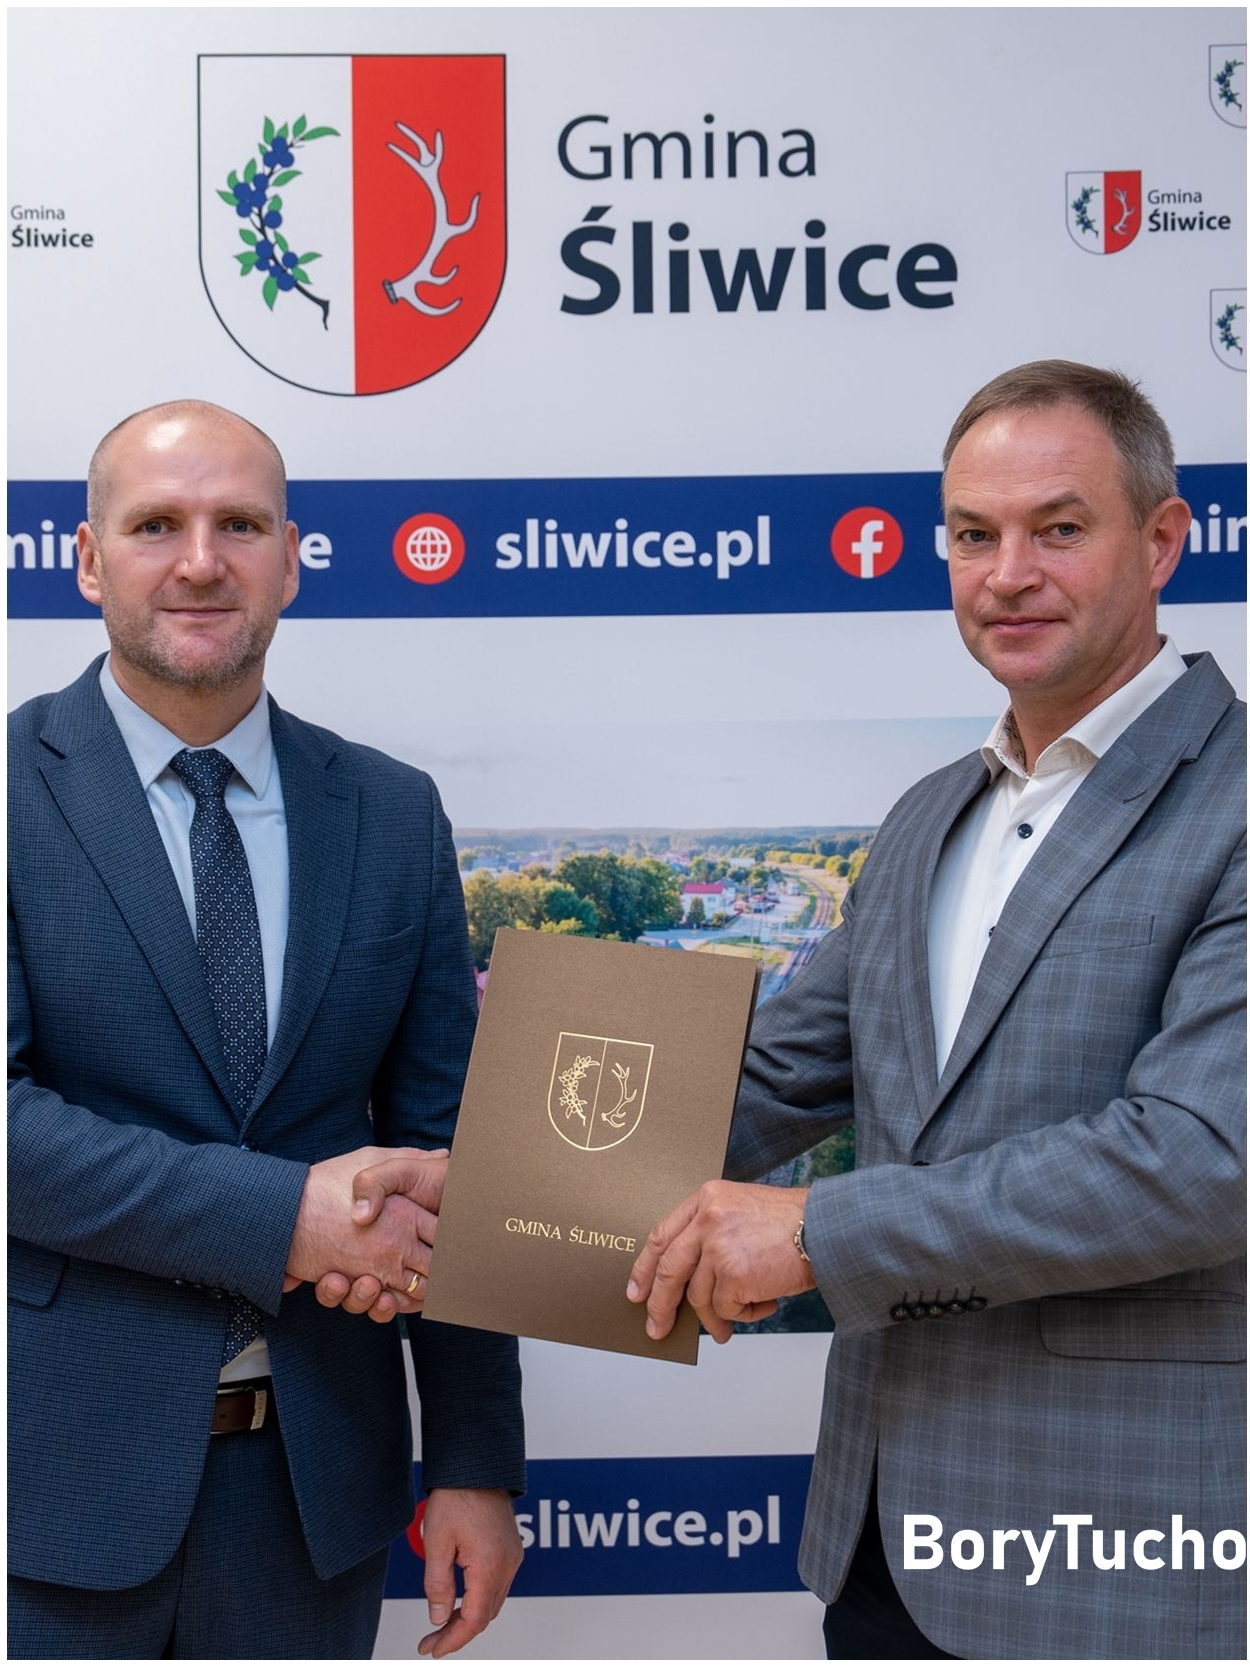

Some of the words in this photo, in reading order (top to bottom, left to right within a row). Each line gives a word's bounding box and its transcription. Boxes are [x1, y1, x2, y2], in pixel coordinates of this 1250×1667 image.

[558, 113, 817, 180] Gmina
[11, 204, 65, 221] Gmina
[1147, 189, 1203, 205] Gmina
[12, 223, 94, 248] Śliwice
[1148, 208, 1232, 232] Śliwice
[560, 206, 958, 315] Śliwice
[496, 515, 771, 579] sliwice.pl
[505, 1217, 562, 1240] GMINA
[569, 1225, 636, 1252] ŚLIWICE
[518, 1495, 780, 1557] sliwice.pl
